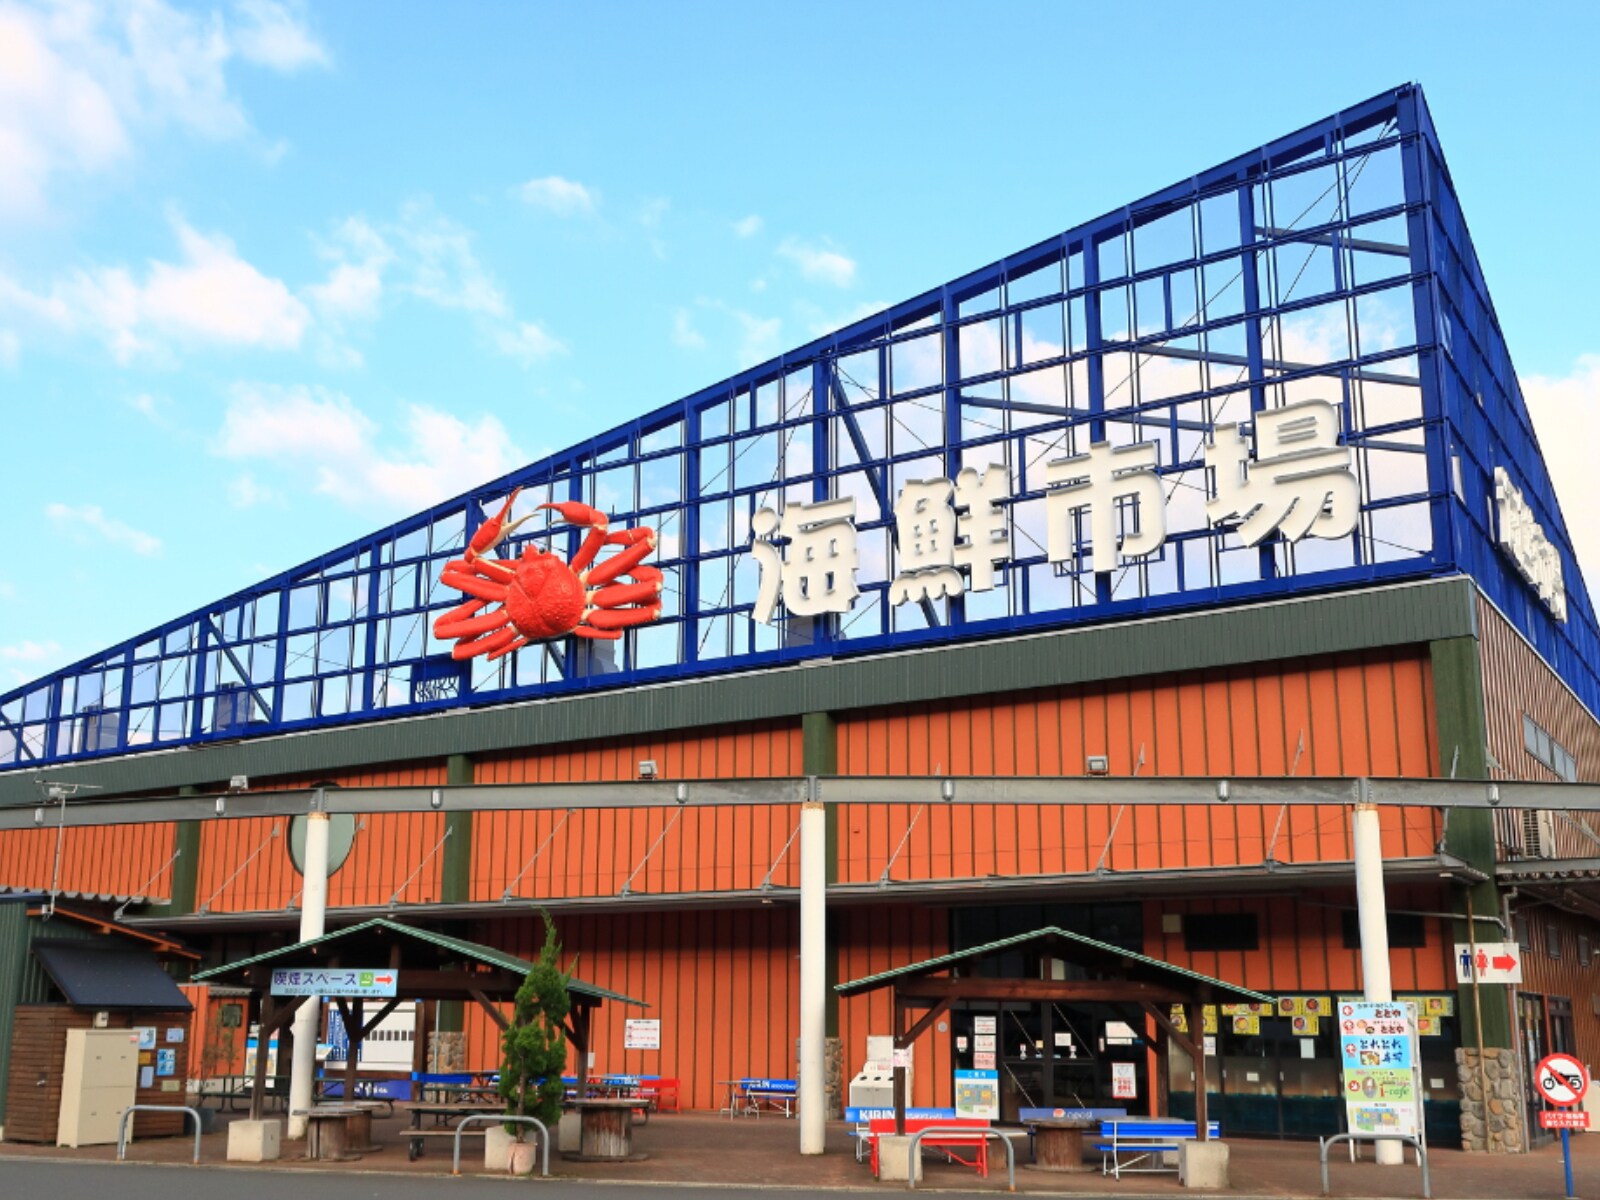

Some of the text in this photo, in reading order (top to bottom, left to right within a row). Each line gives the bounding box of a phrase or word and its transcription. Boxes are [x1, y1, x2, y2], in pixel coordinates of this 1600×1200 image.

[751, 399, 1360, 625] 海鮮市場
[273, 971, 357, 986] 喫煙スペース
[859, 1109, 896, 1120] KIRIN
